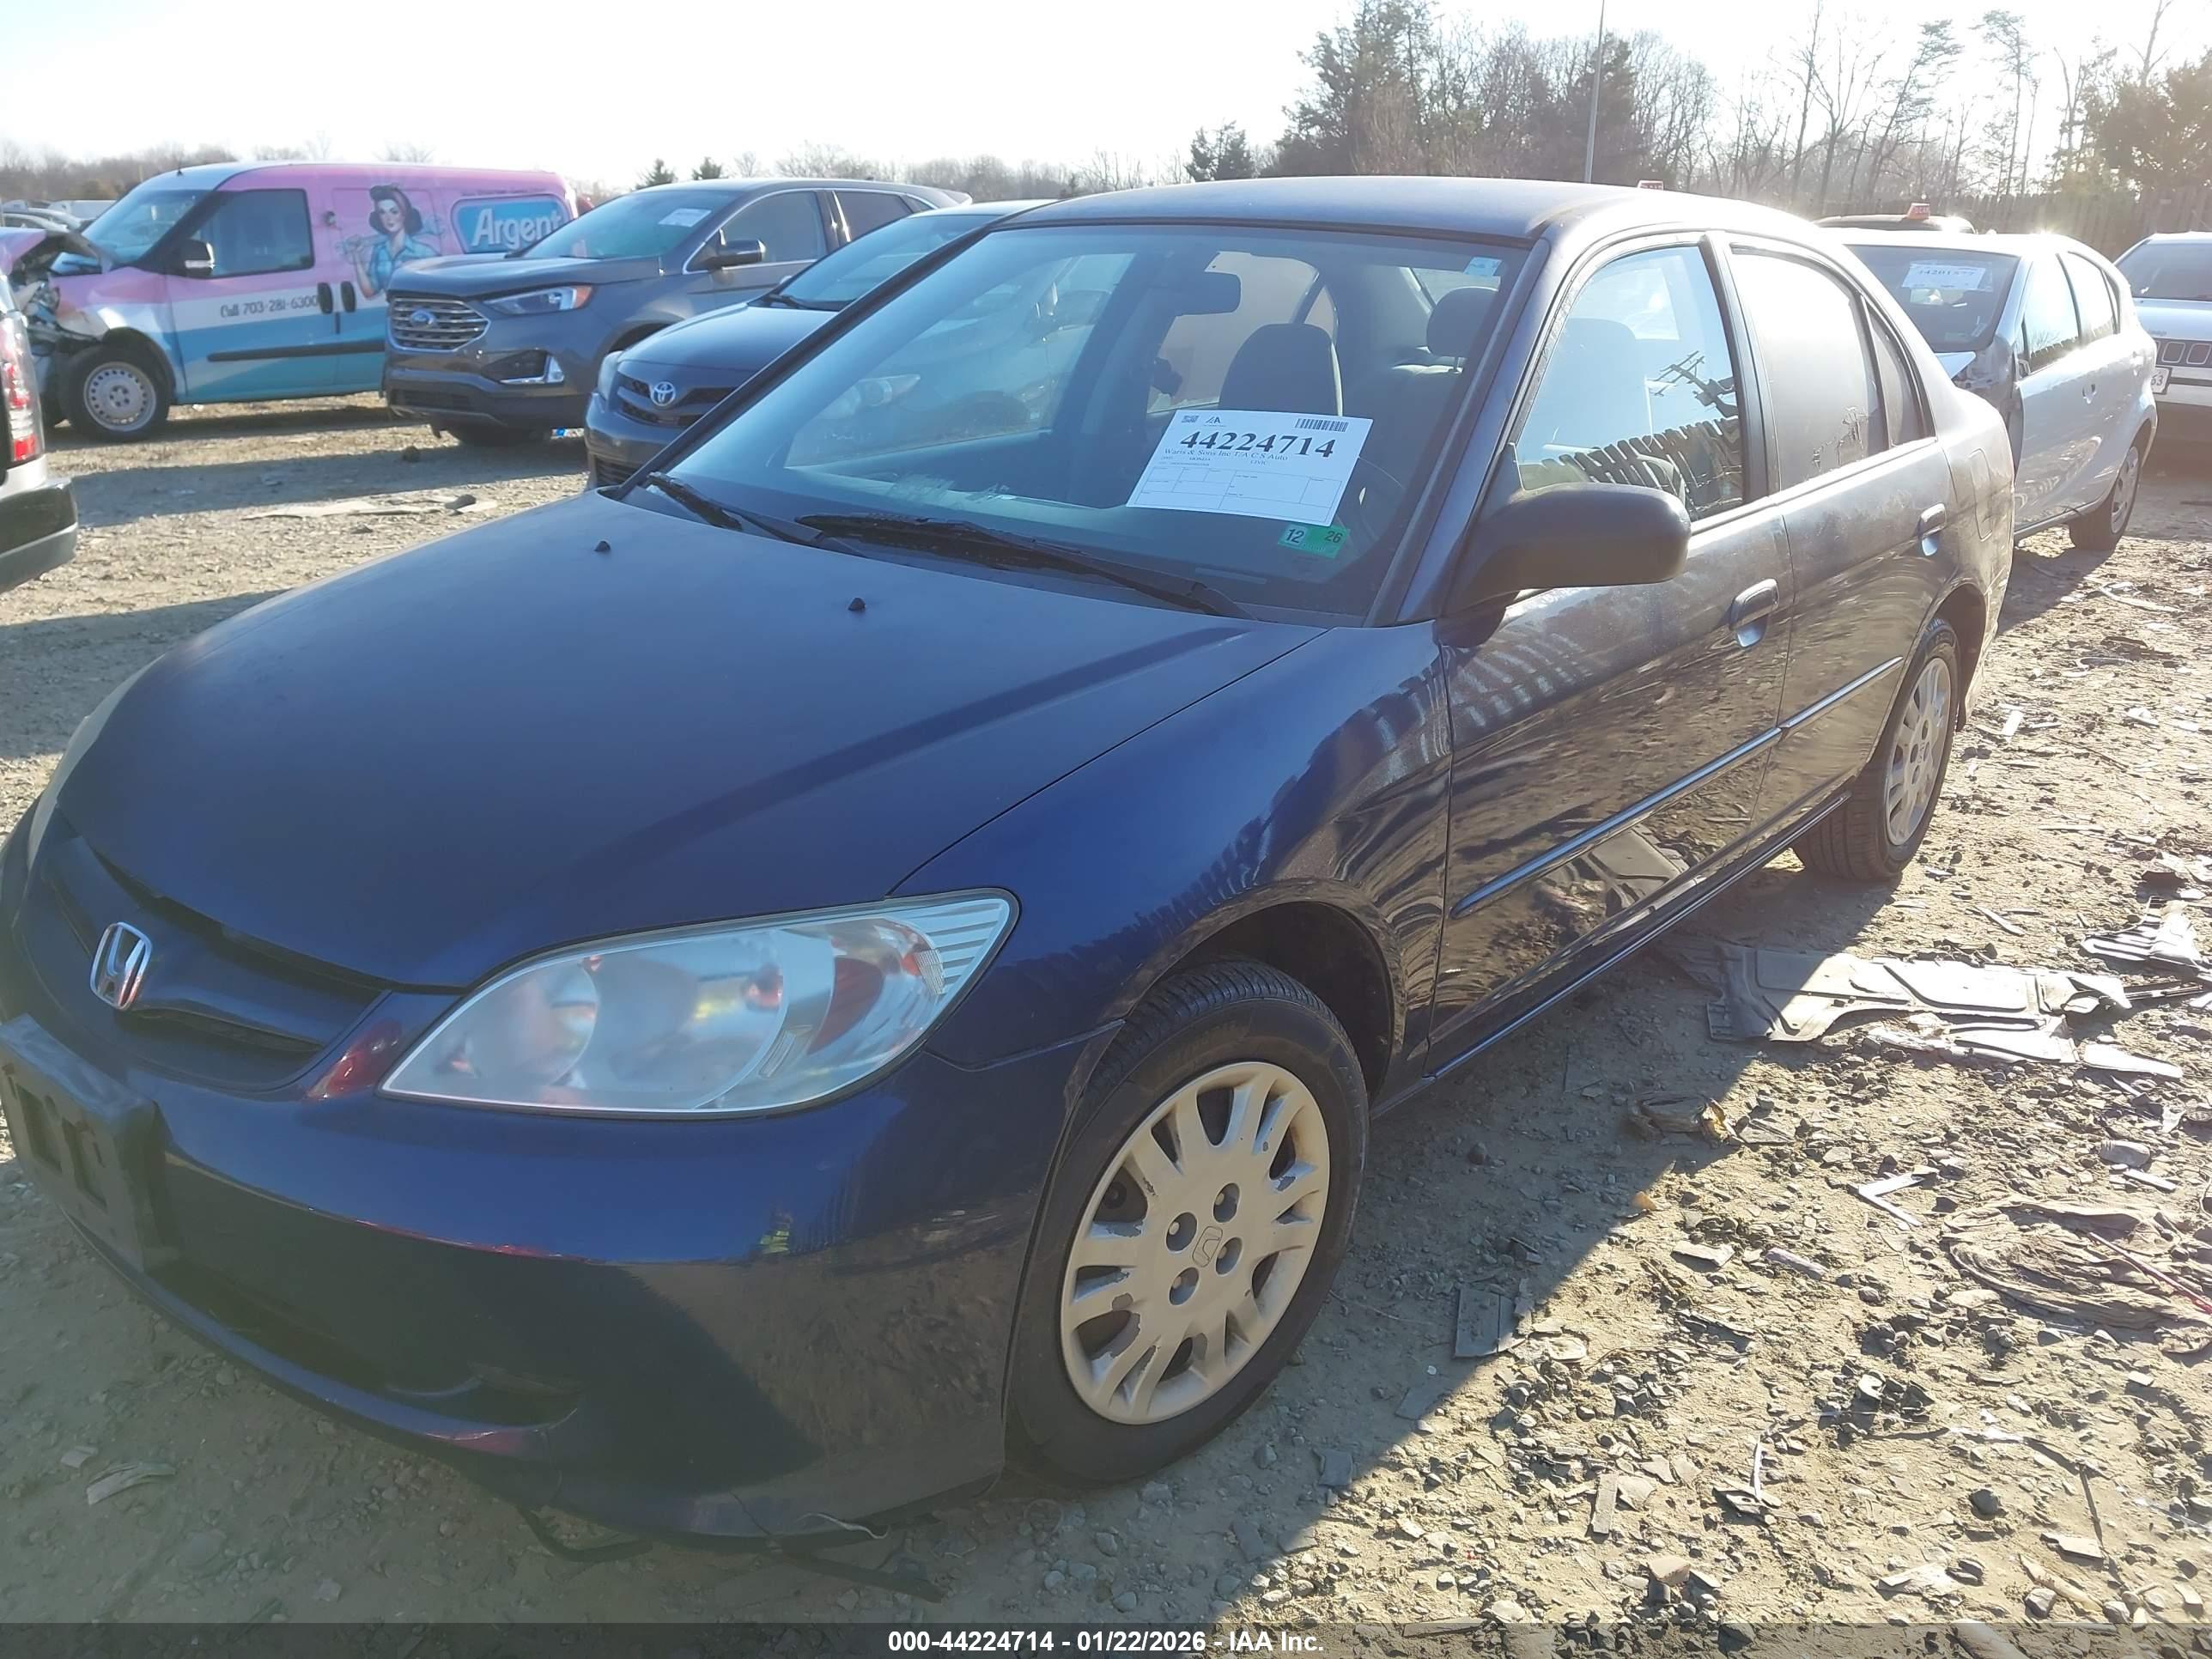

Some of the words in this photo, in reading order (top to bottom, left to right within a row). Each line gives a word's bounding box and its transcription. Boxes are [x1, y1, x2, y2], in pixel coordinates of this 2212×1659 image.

[471, 208, 562, 252] Argent
[220, 303, 240, 318] Call
[243, 295, 319, 315] 703-281-6300
[1180, 431, 1336, 458] 44224714
[1285, 528, 1304, 544] 12
[1324, 530, 1342, 544] 26
